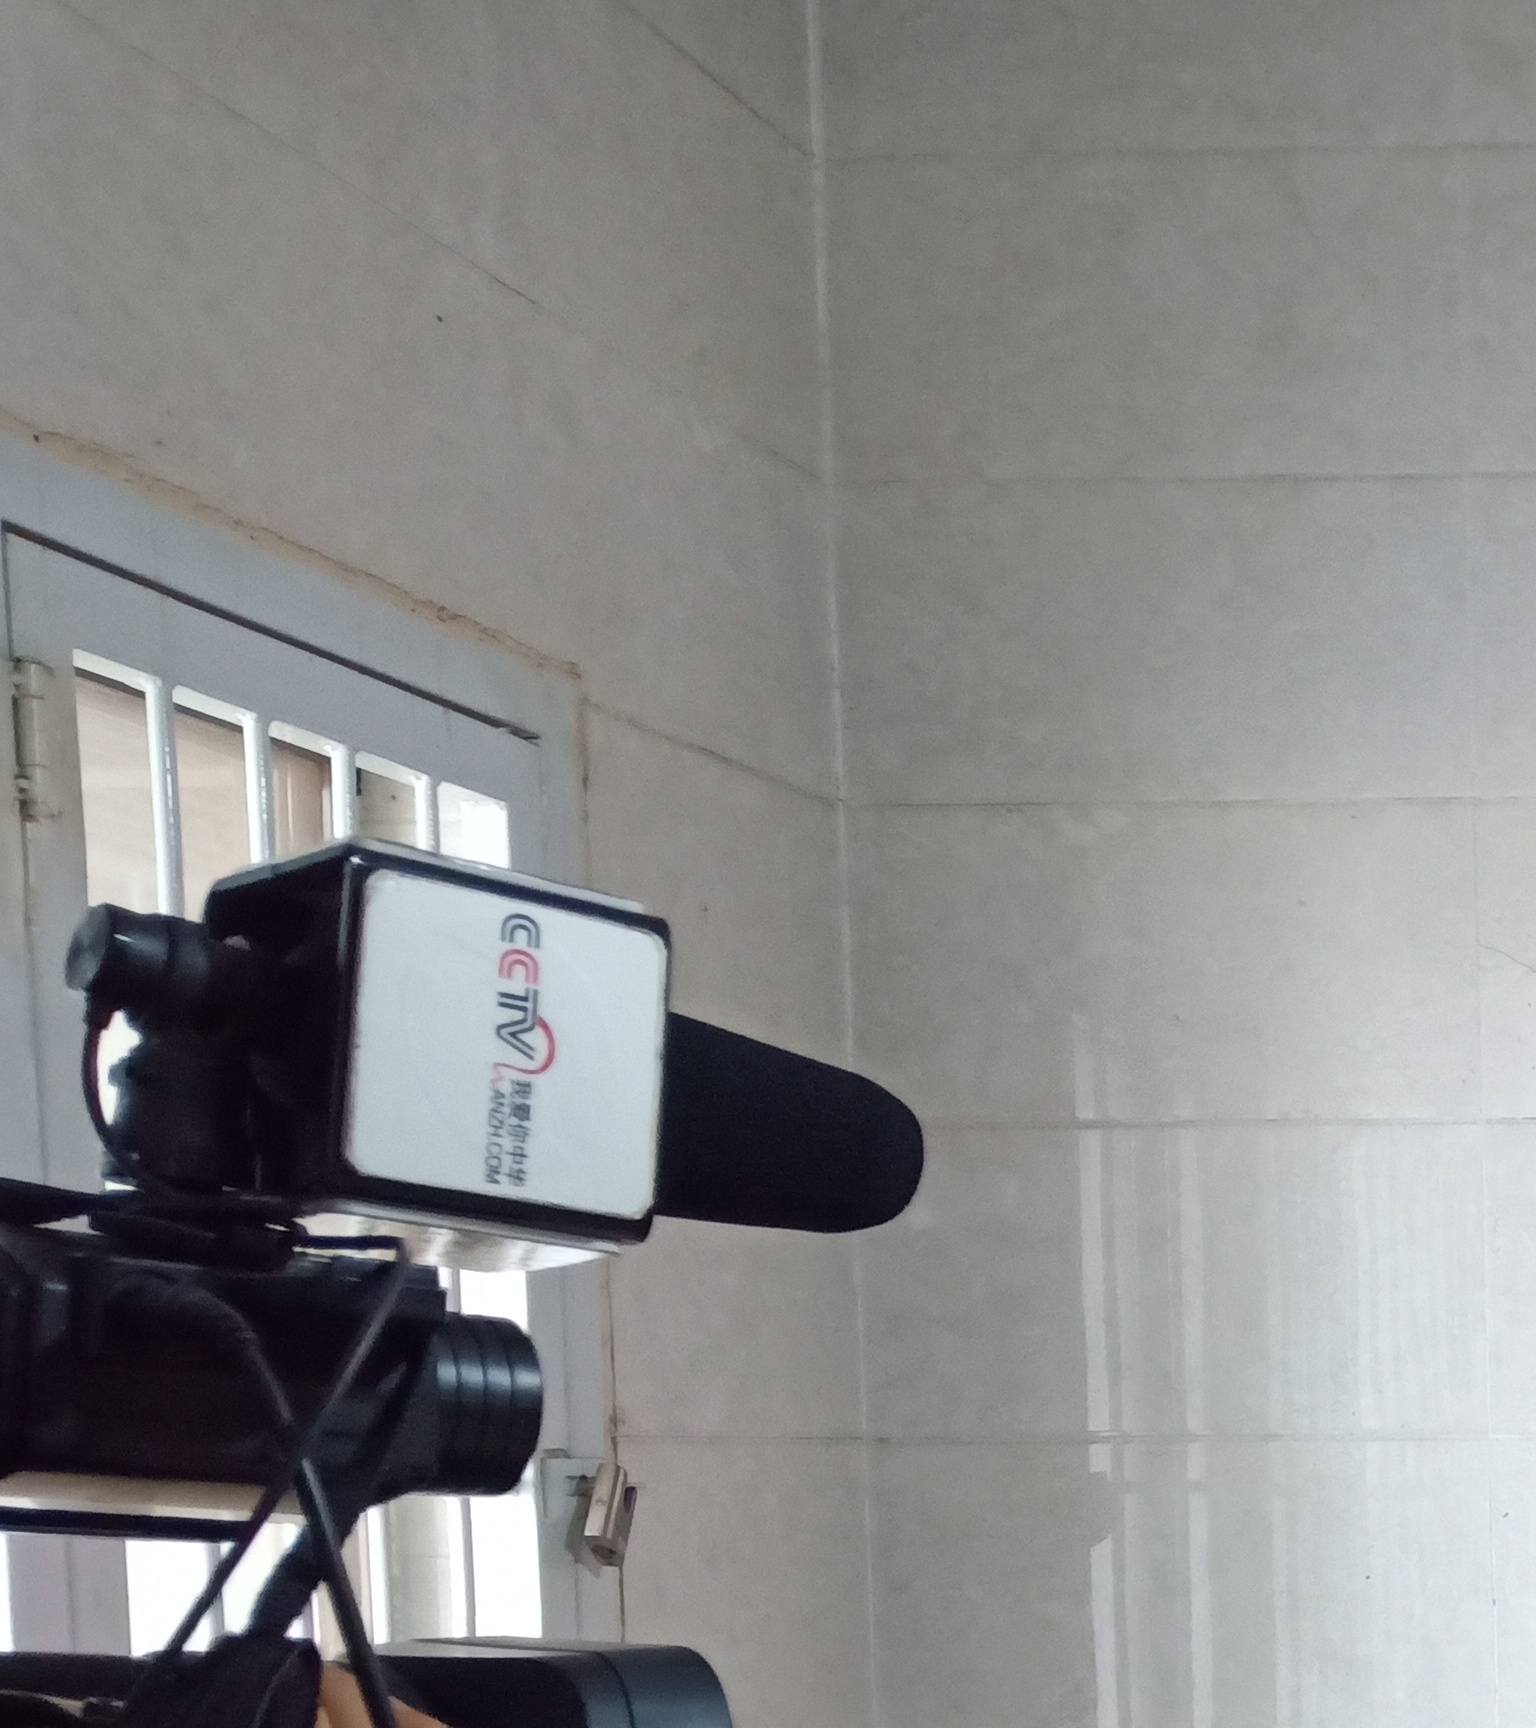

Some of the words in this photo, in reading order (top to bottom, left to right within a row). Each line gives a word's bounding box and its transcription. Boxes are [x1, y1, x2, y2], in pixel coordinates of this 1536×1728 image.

[496, 913, 545, 1063] CCTV
[508, 1079, 532, 1187] 我爱你中华
